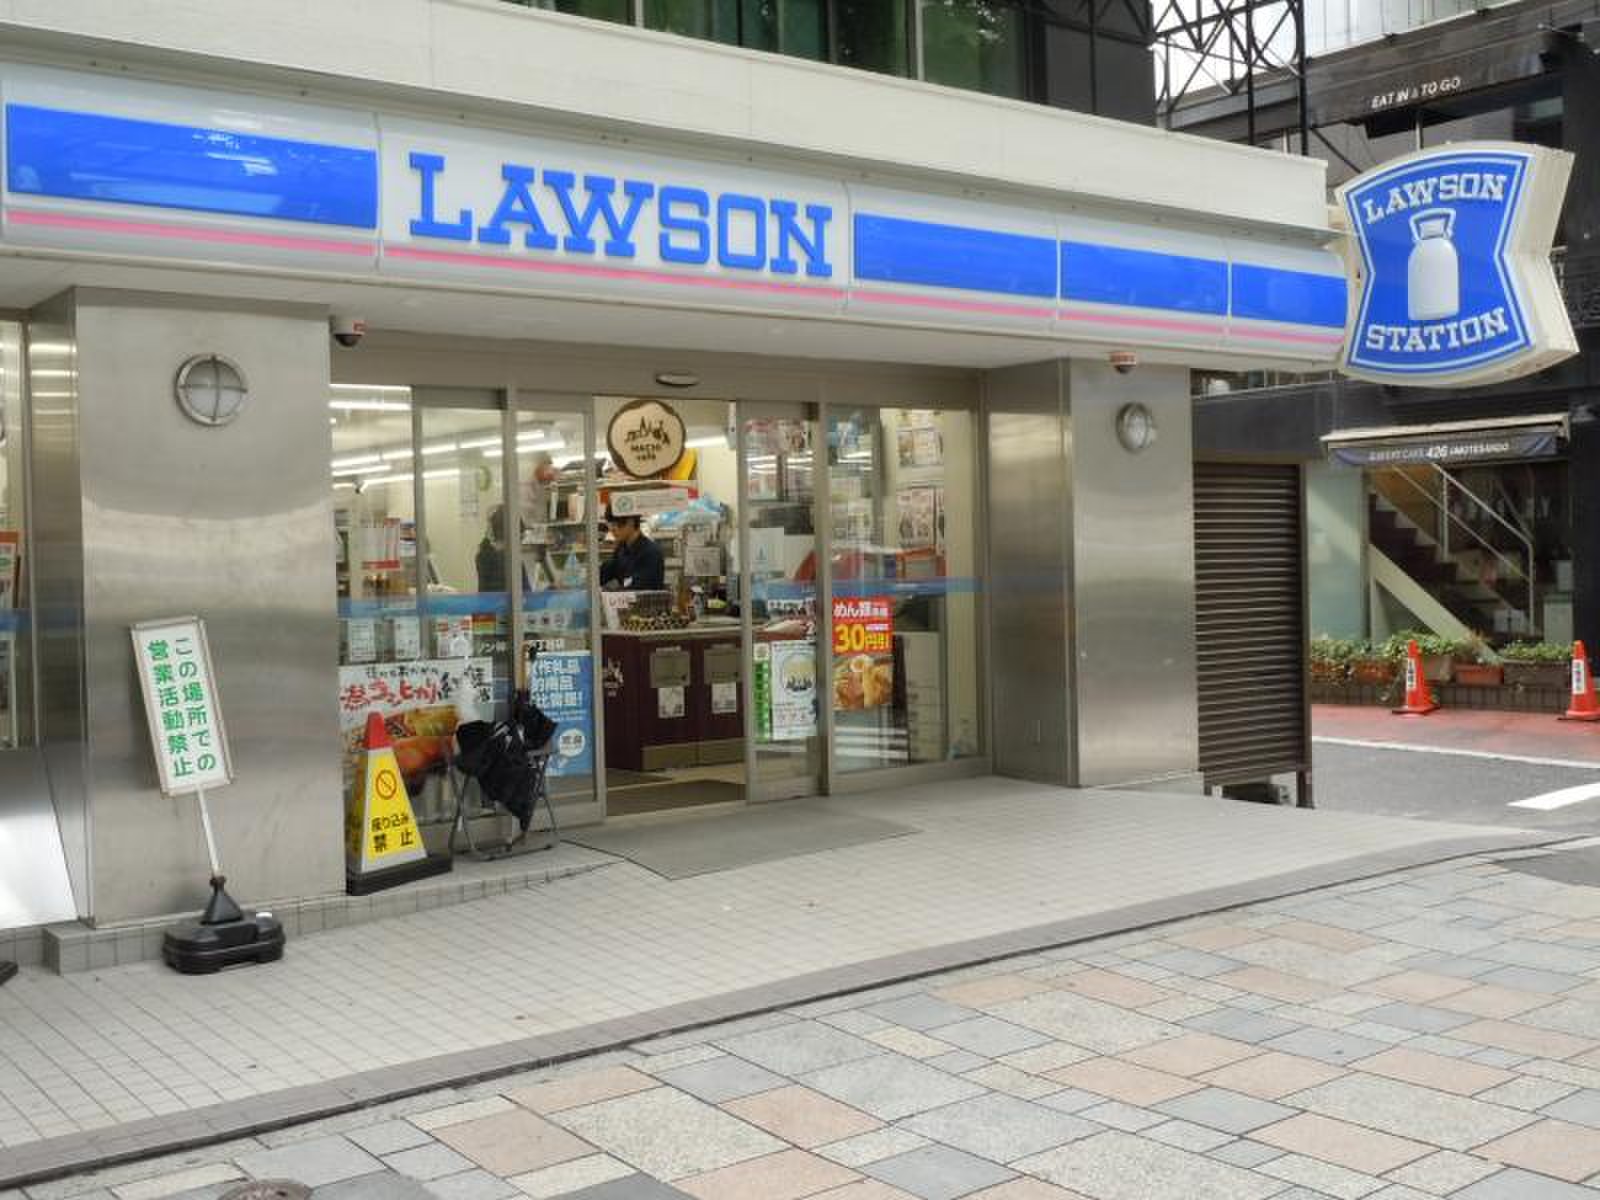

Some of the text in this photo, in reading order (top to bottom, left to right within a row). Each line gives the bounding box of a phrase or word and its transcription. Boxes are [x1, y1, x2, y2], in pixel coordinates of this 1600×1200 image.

[1371, 91, 1395, 109] EAT
[1396, 87, 1409, 102] IN
[1421, 81, 1438, 97] TO
[1440, 76, 1461, 92] GO
[409, 152, 832, 277] LAWSON
[1363, 173, 1507, 224] LAWSON
[1365, 307, 1509, 351] STATION
[1426, 445, 1448, 458] 426
[147, 639, 194, 777] 営業活動禁止
[176, 638, 216, 771] この場所での
[373, 828, 414, 853] 禁止
